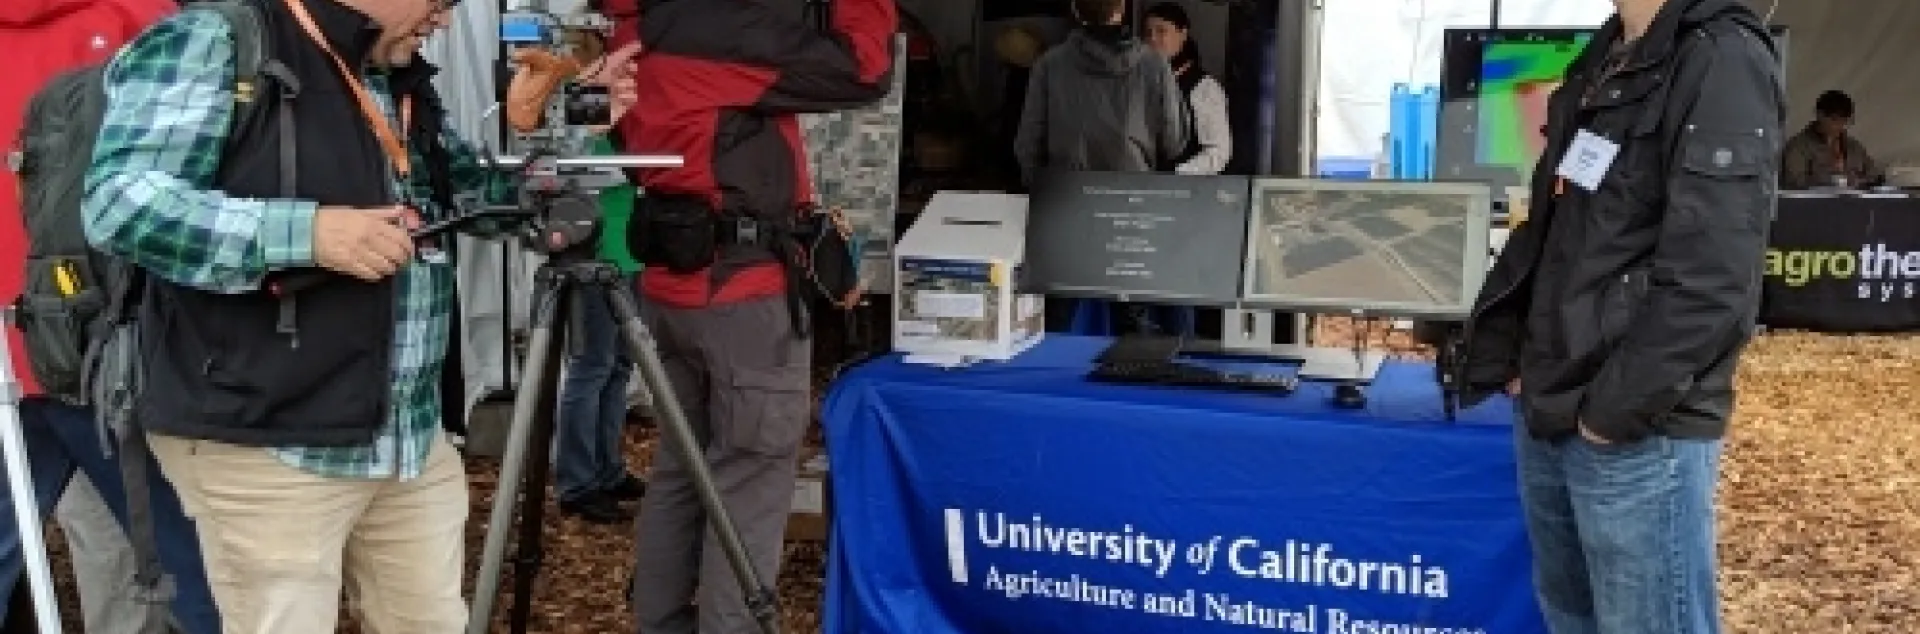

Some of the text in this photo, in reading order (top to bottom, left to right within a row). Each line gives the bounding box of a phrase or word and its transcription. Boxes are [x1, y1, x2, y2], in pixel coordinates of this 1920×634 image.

[977, 509, 1449, 598] University of California
[984, 565, 1135, 609] Agriculture
[1142, 588, 1196, 617] and
[1202, 592, 1317, 633] Natural
